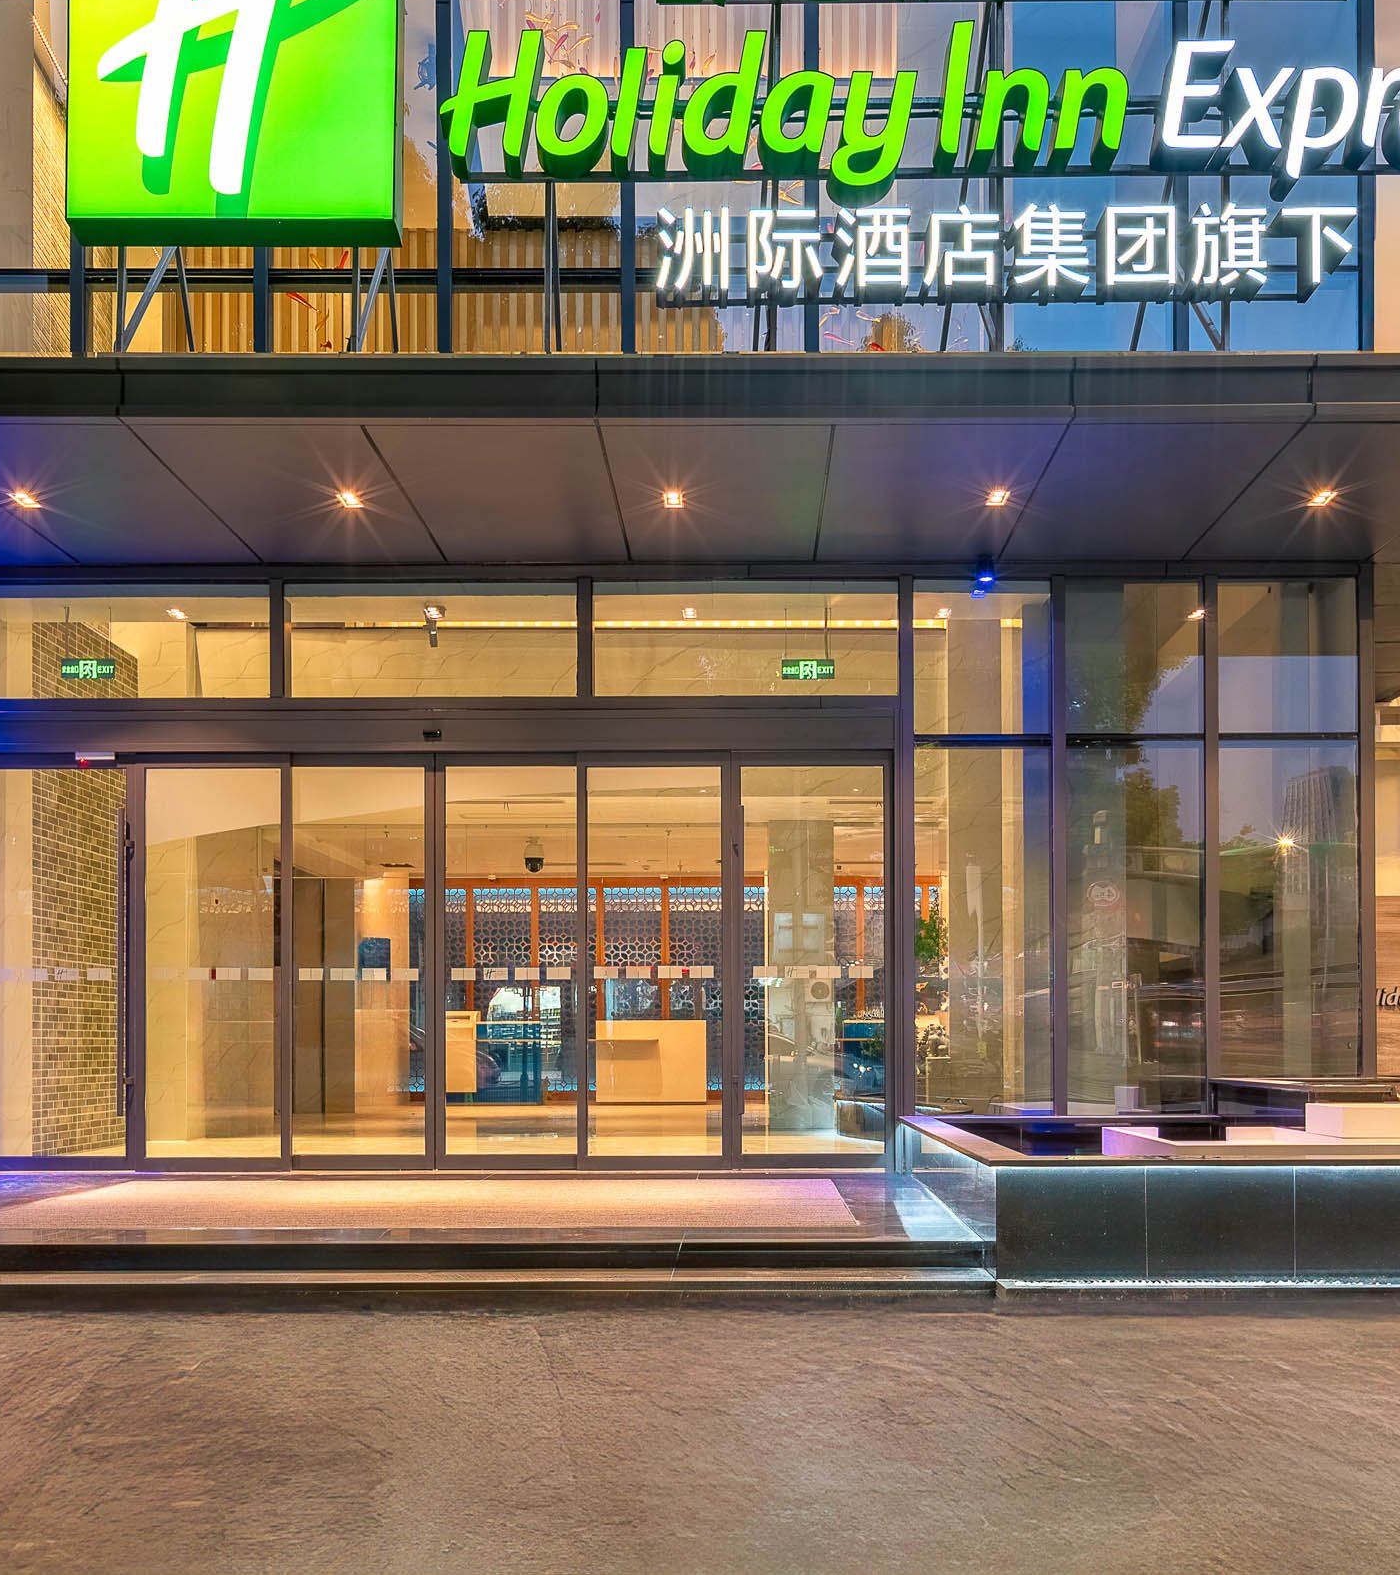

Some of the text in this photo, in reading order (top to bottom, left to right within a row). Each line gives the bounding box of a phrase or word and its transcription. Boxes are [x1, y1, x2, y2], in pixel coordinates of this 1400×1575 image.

[440, 29, 918, 188] Holiday
[939, 20, 1129, 155] Inn
[656, 202, 1358, 288] 洲际酒店集团旗下
[97, 666, 115, 674] EXIT
[817, 666, 834, 674] EXIT
